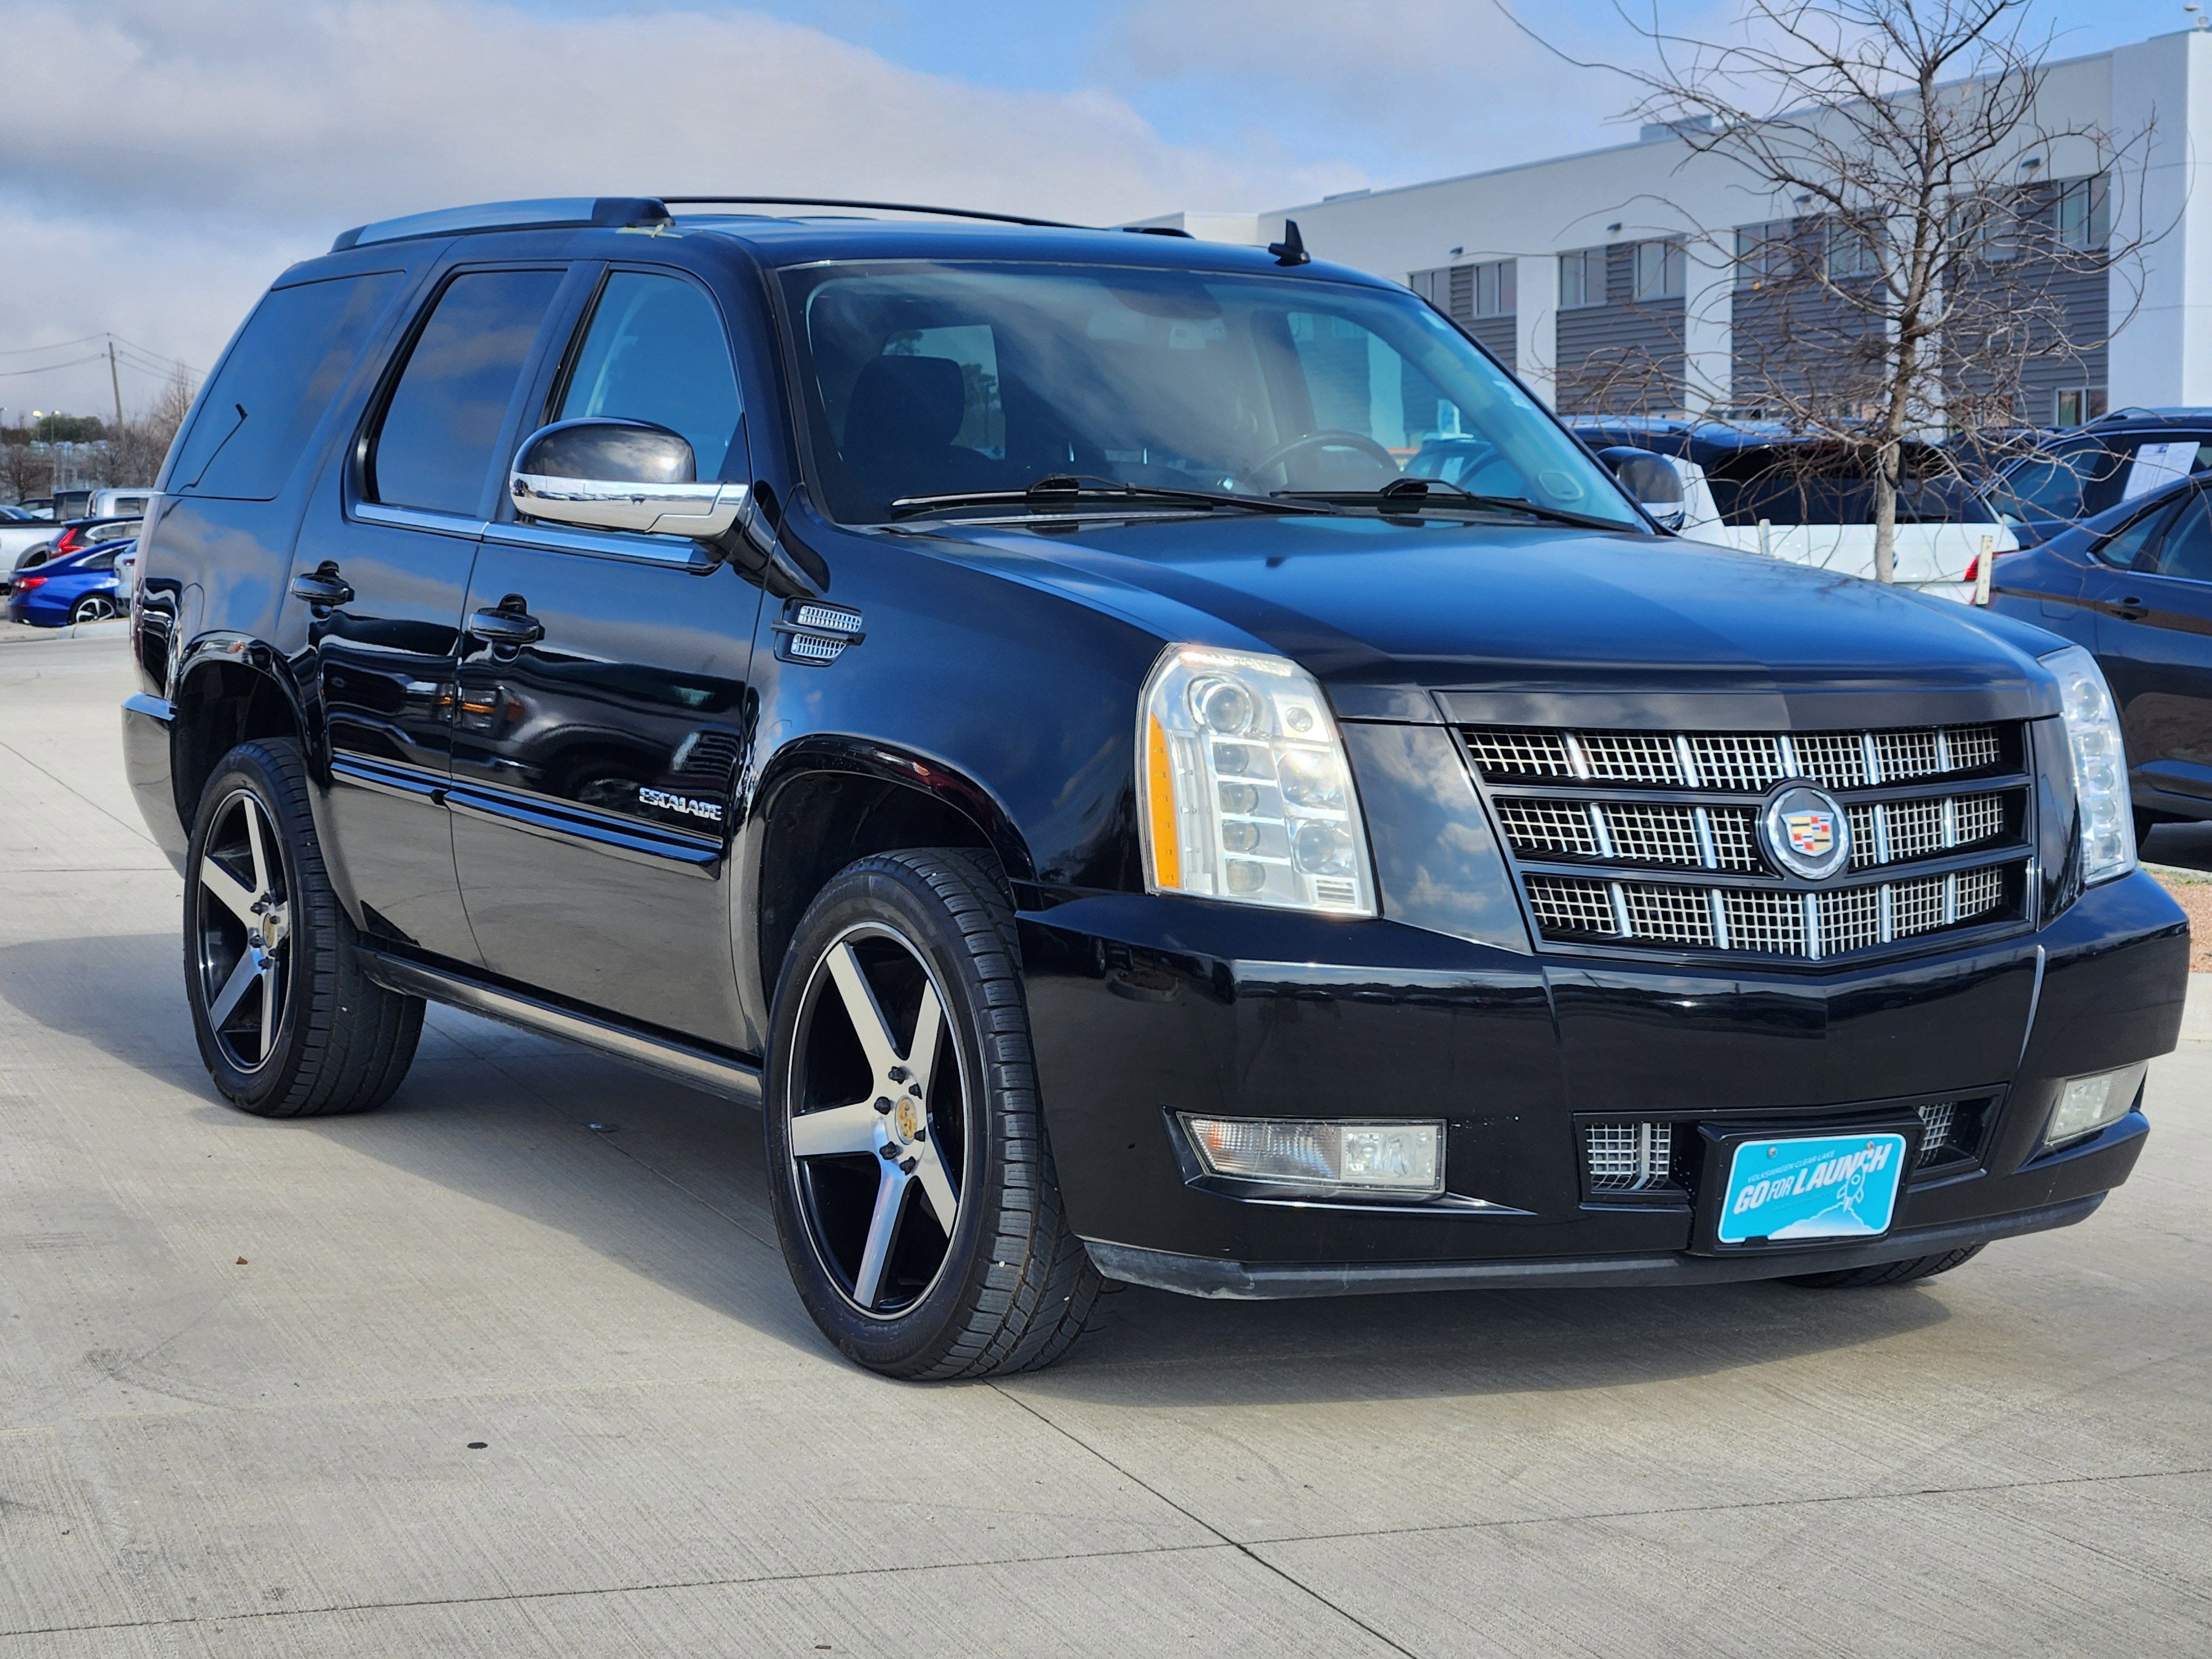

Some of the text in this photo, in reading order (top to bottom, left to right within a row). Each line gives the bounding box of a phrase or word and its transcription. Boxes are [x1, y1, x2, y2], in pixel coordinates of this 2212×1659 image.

[639, 787, 722, 821] ESCALADE
[1733, 1180, 1770, 1214] GO
[1766, 1175, 1795, 1202] FOR
[1792, 1143, 1893, 1196] LAUNCH
[1747, 1149, 1836, 1183] VOLKSWAGEN CLEAR LAKE
